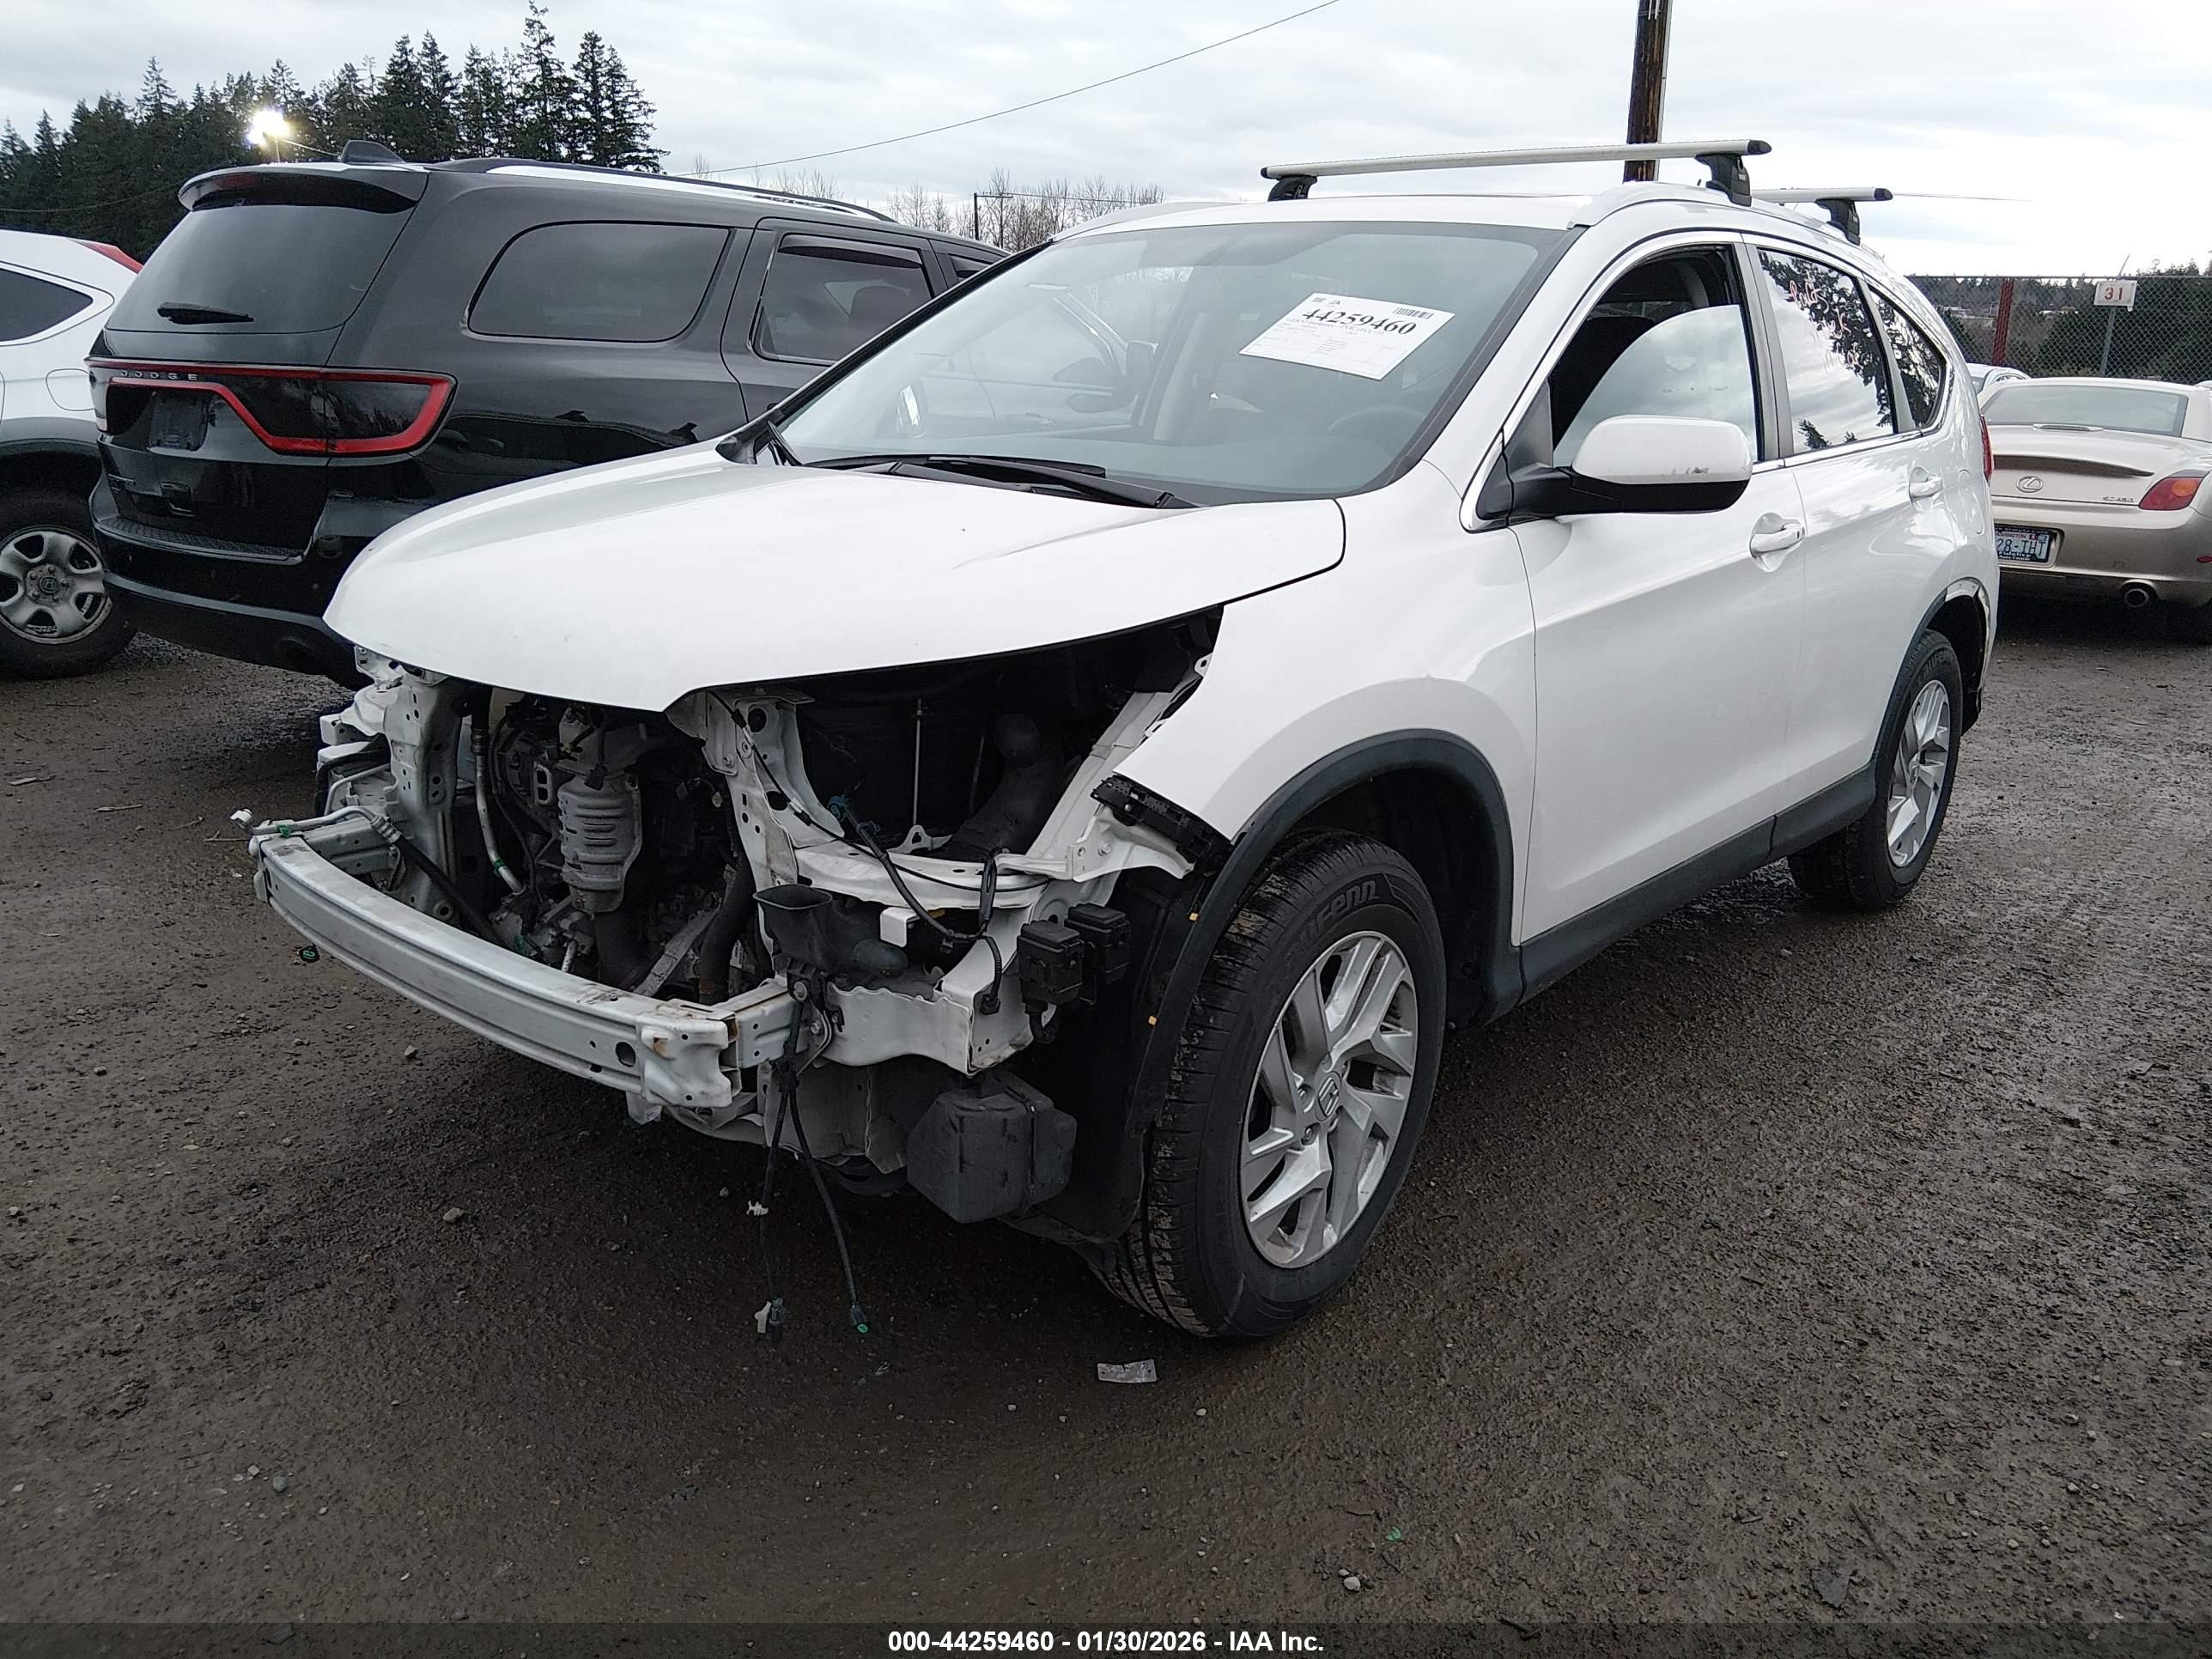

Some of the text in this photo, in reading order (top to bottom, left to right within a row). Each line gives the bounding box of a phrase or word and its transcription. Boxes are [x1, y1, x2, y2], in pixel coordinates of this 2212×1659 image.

[2105, 287, 2124, 301] 31
[1302, 308, 1418, 335] 44259460
[1996, 538, 2046, 557] 28-THT
